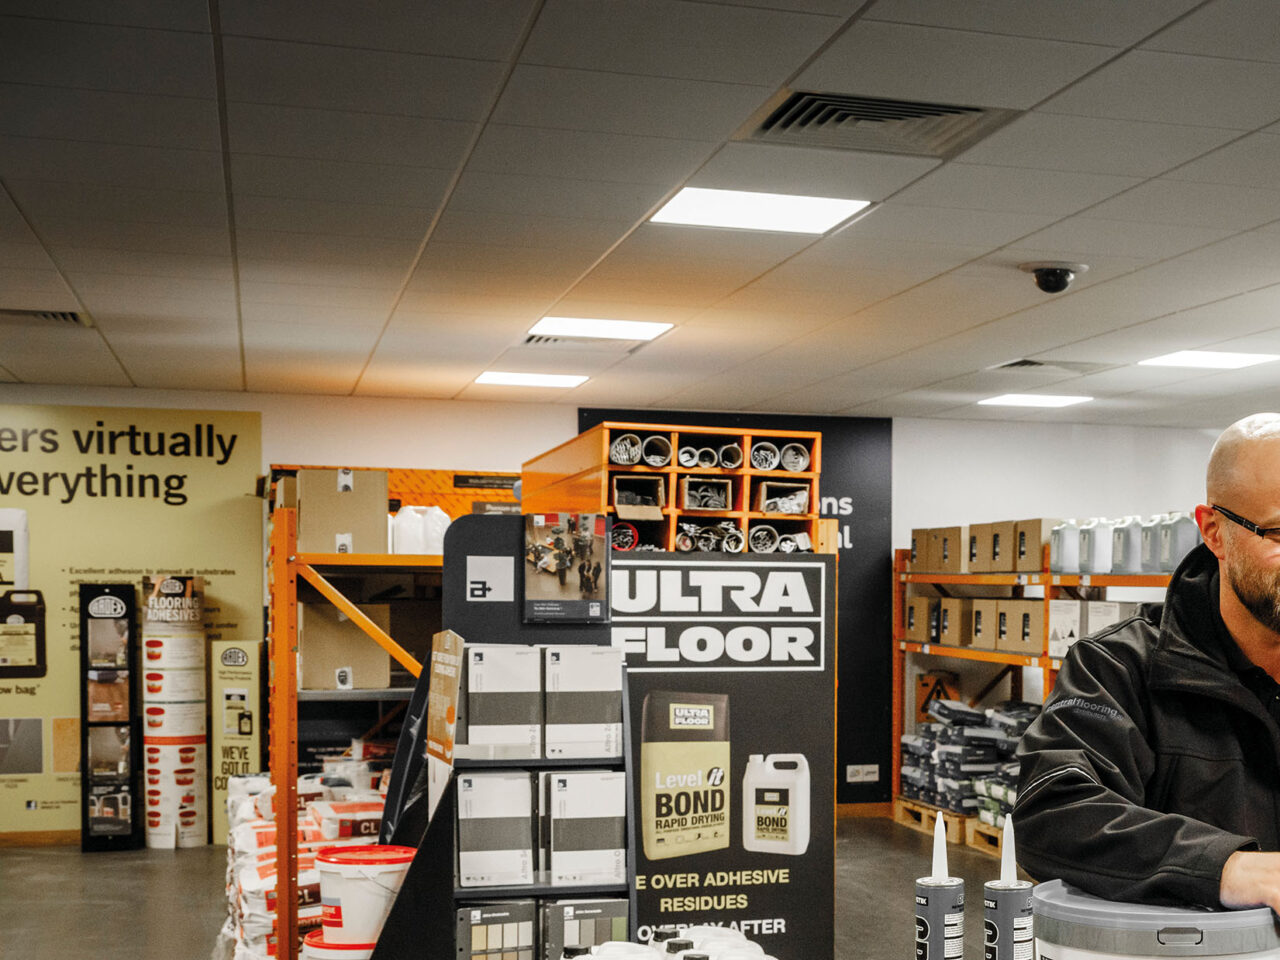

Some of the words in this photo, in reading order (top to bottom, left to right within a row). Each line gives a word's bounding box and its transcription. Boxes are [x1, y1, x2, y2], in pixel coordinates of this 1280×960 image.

[72, 421, 238, 465] virtually
[611, 570, 814, 613] ULTRA
[147, 597, 200, 609] FLOORING
[147, 610, 200, 621] ADHESIVES
[611, 626, 815, 662] FLOOR
[676, 709, 709, 717] ULTRA
[655, 770, 703, 789] Level
[655, 789, 725, 818] BOND
[656, 818, 688, 830] RAPID
[692, 812, 725, 826] DRYING
[757, 816, 787, 828] BOND
[636, 876, 647, 890] E
[651, 872, 700, 889] OVER
[704, 869, 790, 887] ADHESIVE
[660, 894, 748, 913] RESIDUES
